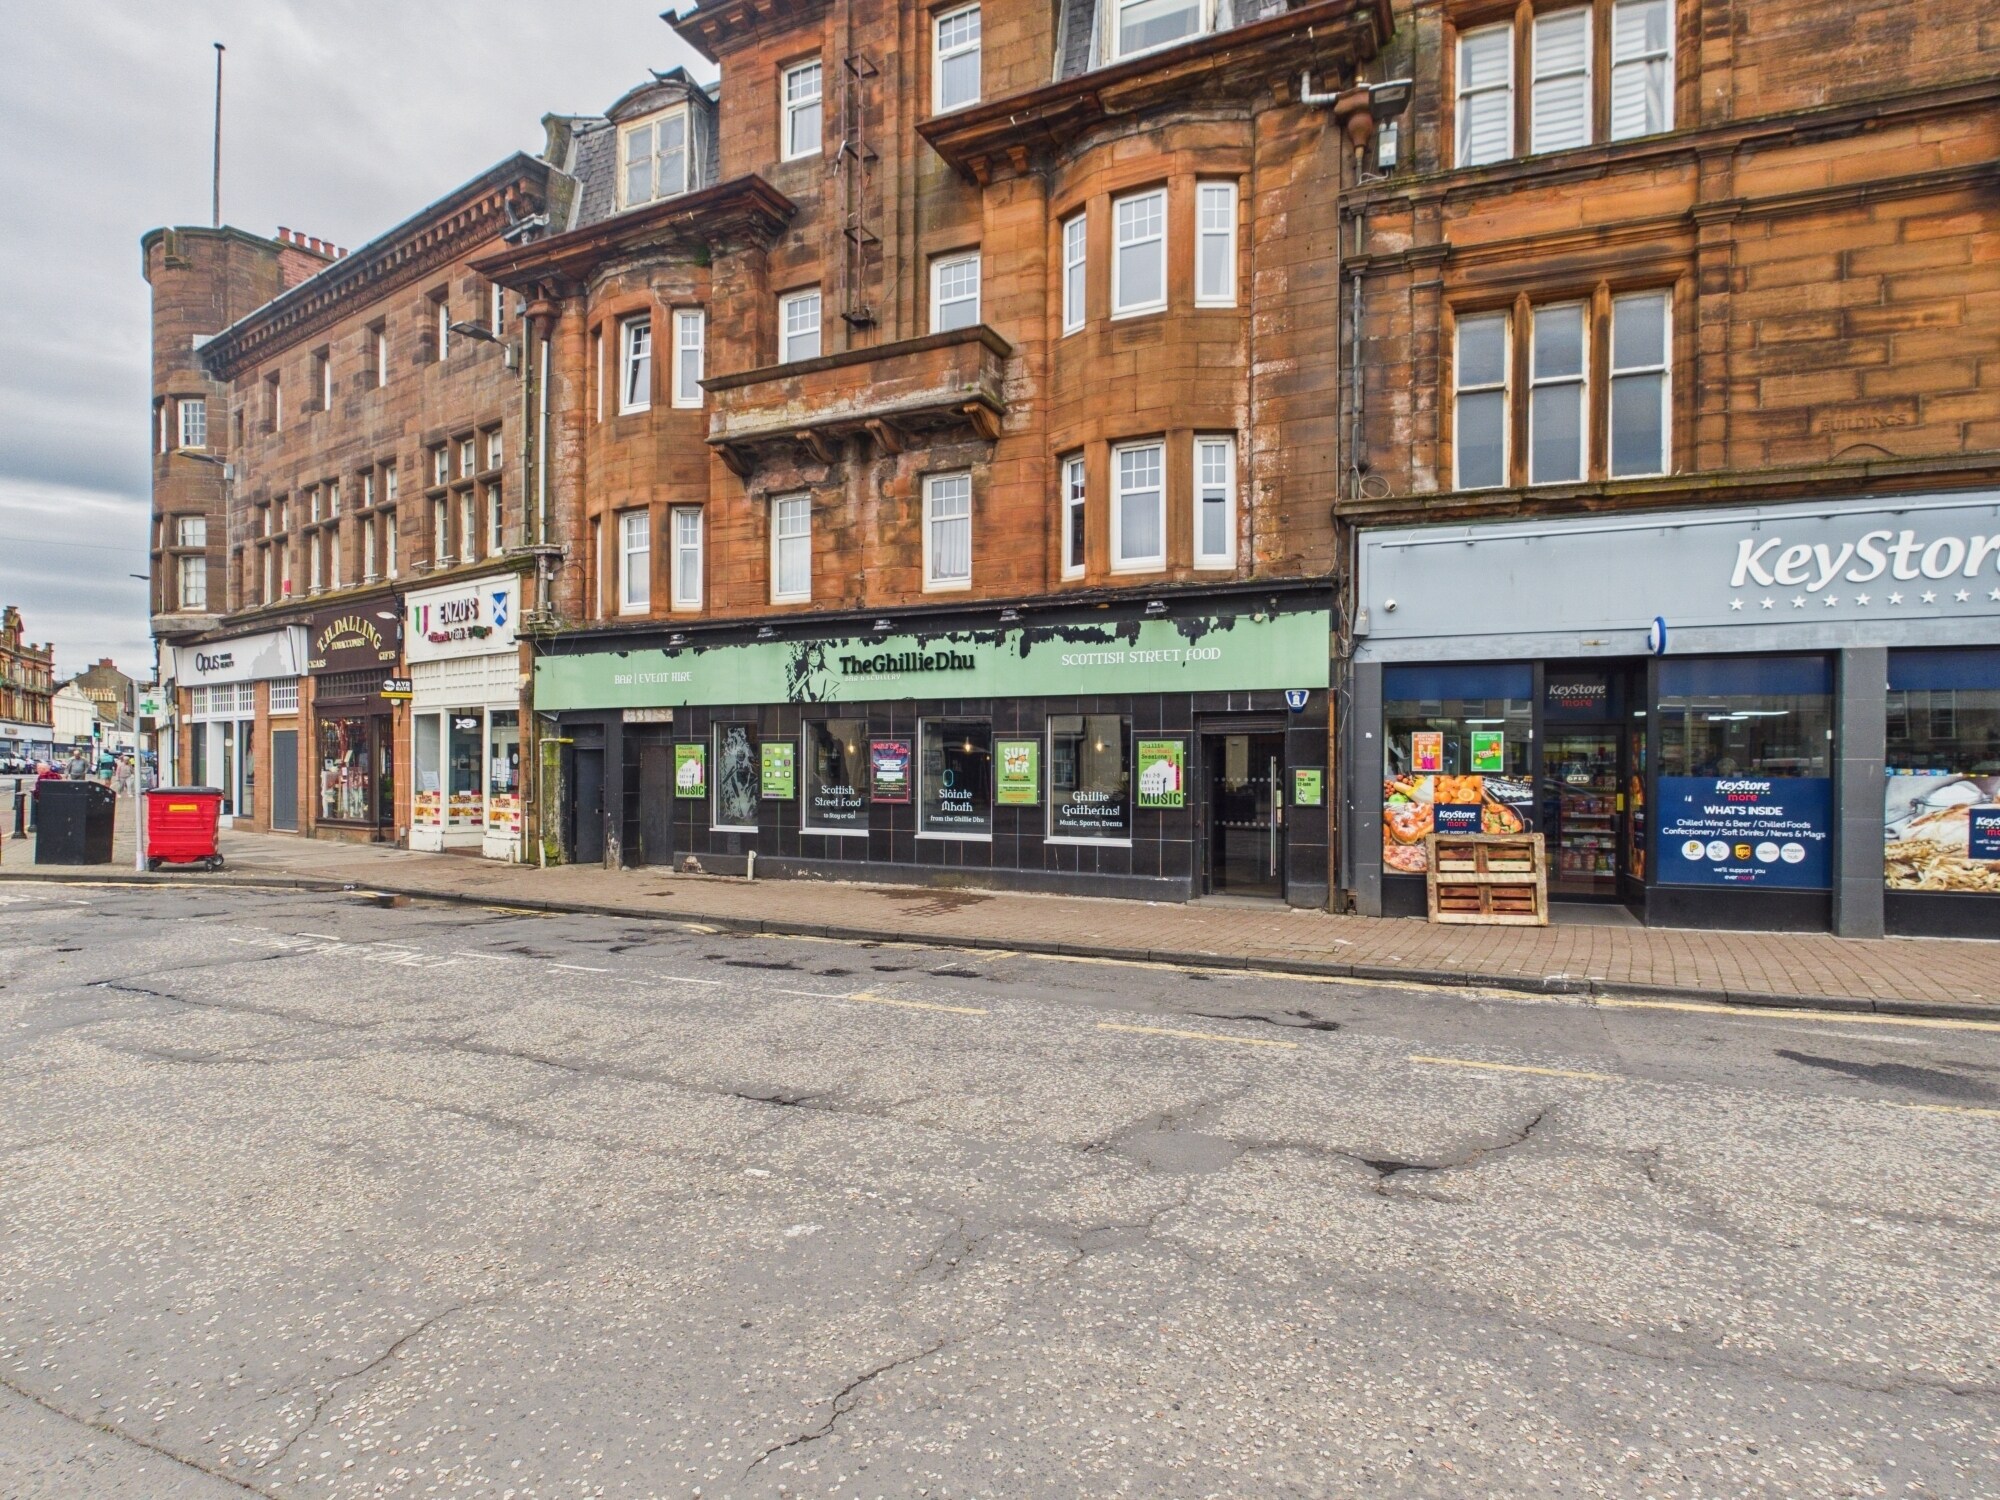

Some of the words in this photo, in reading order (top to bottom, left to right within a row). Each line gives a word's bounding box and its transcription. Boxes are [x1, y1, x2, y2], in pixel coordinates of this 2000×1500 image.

[1730, 530, 2000, 593] KeyStor
[440, 598, 479, 624] ENZO'S
[379, 651, 396, 660] GIFTS
[1061, 652, 1125, 666] SCOTTISH
[1129, 649, 1181, 663] STREET
[1186, 647, 1221, 661] FOOD
[195, 653, 219, 676] Opus
[839, 650, 976, 675] TheGhillieDhu
[614, 675, 632, 684] BAR
[639, 673, 669, 683] EVENT
[671, 672, 693, 682] HIRE
[1549, 684, 1606, 696] KeyStore
[1562, 699, 1593, 707] more
[677, 785, 704, 796] MUSIC
[821, 785, 855, 795] Scottish
[1715, 780, 1771, 792] KeyStore
[815, 797, 838, 807] Street
[841, 798, 862, 807] Food
[1072, 791, 1110, 804] Ghillie
[1141, 792, 1181, 805] MUSIC
[1438, 810, 1476, 819] KeyStore
[1704, 806, 1746, 815] WHAT'S
[1748, 807, 1783, 816] INSIDE
[1079, 820, 1101, 828] Sports,
[1676, 819, 1703, 827] Chilled
[1758, 821, 1785, 829] Chilled
[1662, 828, 1715, 837] Confectionery
[1770, 830, 1794, 838] News
[1803, 832, 1826, 840] Mags
